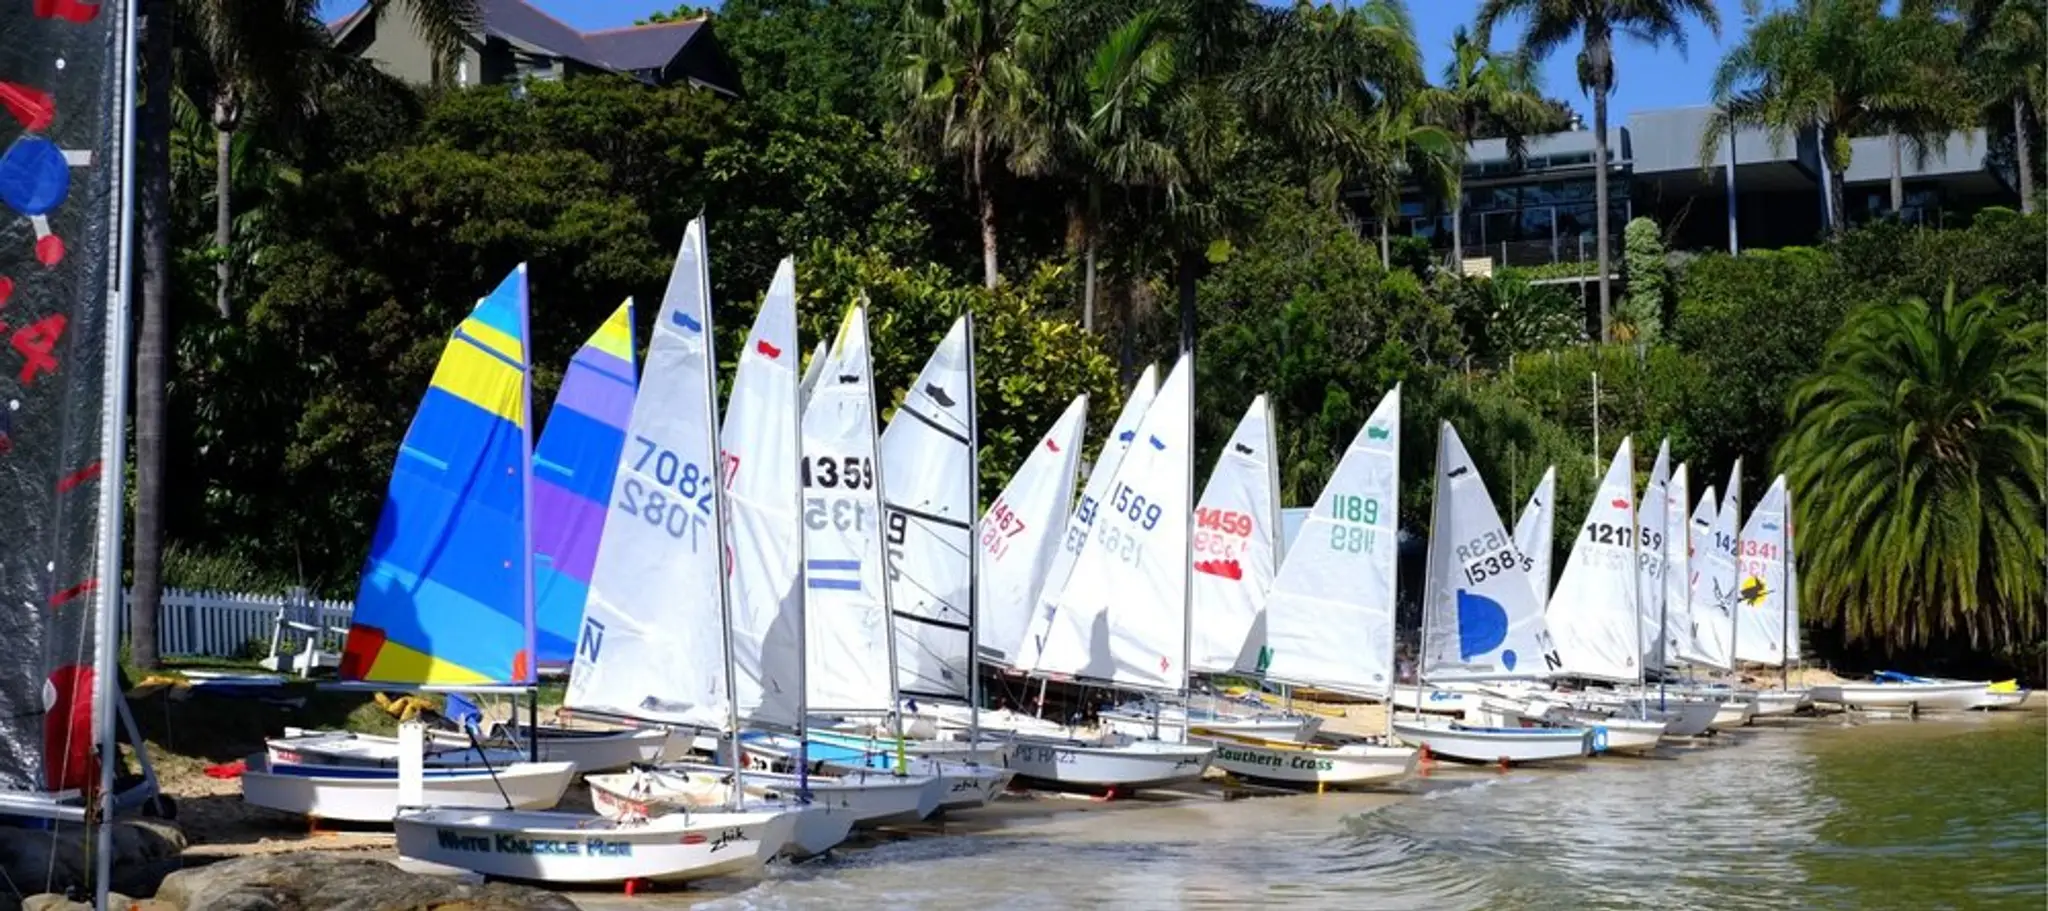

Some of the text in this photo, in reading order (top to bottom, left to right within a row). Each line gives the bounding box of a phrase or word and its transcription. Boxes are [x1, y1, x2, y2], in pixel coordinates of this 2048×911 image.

[635, 435, 713, 516] 7082
[801, 456, 873, 490] 1359
[991, 497, 1025, 538] 1467
[1110, 480, 1162, 531] 1569
[1195, 507, 1252, 537] 1459
[1332, 494, 1378, 525] 1189
[1464, 550, 1515, 586] 1538
[1544, 650, 1562, 671] N
[1217, 745, 1333, 771] Southern Cross
